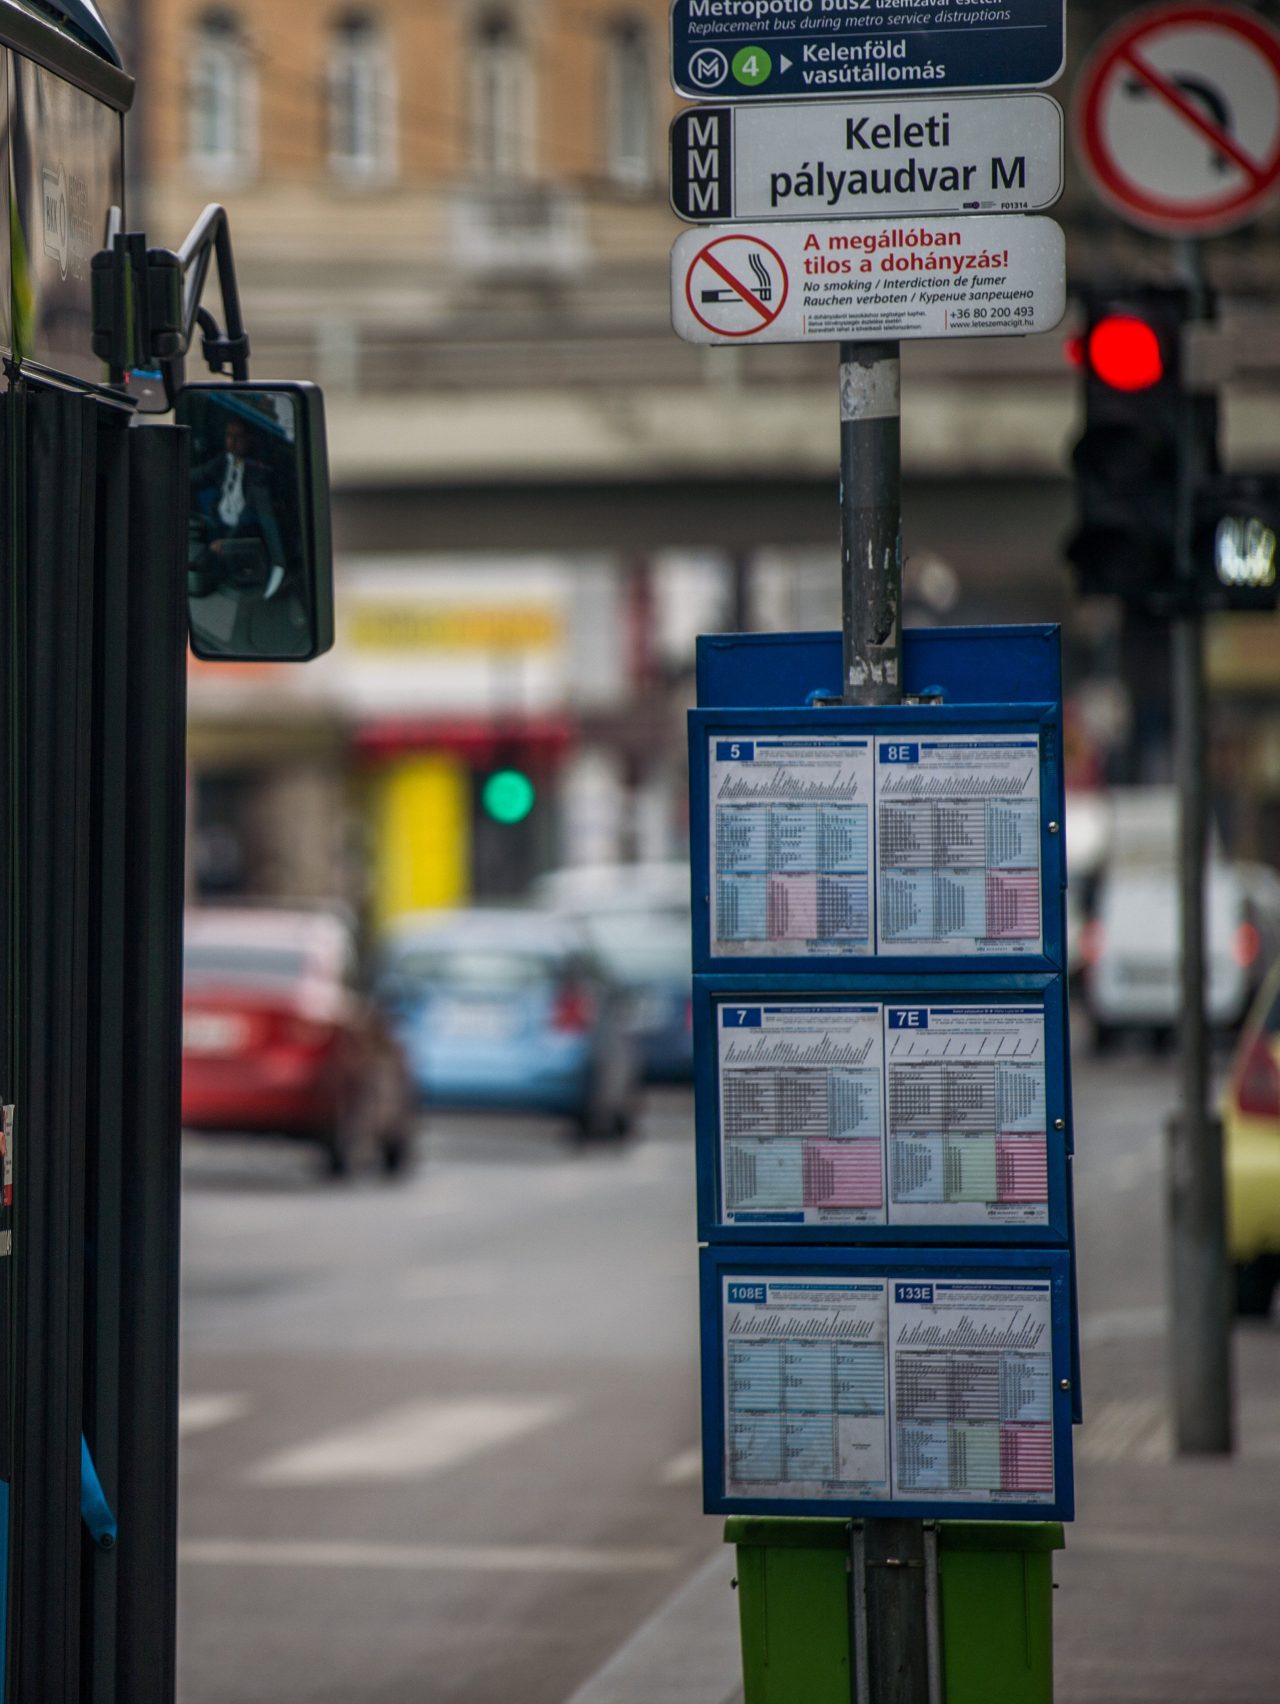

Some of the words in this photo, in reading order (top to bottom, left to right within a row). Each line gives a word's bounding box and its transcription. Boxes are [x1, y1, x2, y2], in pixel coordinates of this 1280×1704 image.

[821, 0, 871, 11] busz
[688, 19, 770, 36] Replacement
[774, 18, 796, 30] bus
[800, 16, 841, 31] during
[845, 15, 884, 26] metro
[887, 12, 931, 24] service
[934, 9, 1011, 24] distruptions
[741, 55, 760, 77] 4
[802, 39, 907, 62] Kelenföld
[802, 60, 946, 84] vasútállomás
[688, 116, 719, 147] M
[846, 112, 950, 150] Keleti
[688, 149, 719, 179] M
[770, 158, 977, 208] pályaudvar
[991, 156, 1026, 190] M
[688, 182, 719, 212] M
[1000, 201, 1028, 210] F01314
[804, 233, 820, 251] A
[828, 228, 961, 254] megállóban
[804, 255, 852, 275] tilos
[860, 258, 872, 272] a
[880, 250, 1008, 275] dohányzás!
[803, 282, 820, 292] No
[824, 280, 872, 292] smoking
[883, 276, 950, 289] Interdiction
[954, 276, 968, 287] de
[970, 274, 1006, 289] fumer
[803, 294, 852, 306] Rauchen
[856, 293, 908, 304] verboten
[919, 291, 966, 304] Курение
[968, 290, 1034, 302] запрещено
[950, 308, 970, 319] +36
[973, 308, 988, 318] 80
[990, 307, 1011, 318] 200
[1013, 306, 1034, 317] 493
[950, 318, 1034, 328] www.leteszemacigit.hu
[730, 744, 740, 759] 5
[888, 746, 910, 761] 8E
[736, 1010, 746, 1024] 7
[896, 1012, 920, 1026] 7E
[731, 1287, 764, 1300] 108E
[898, 1287, 931, 1300] 133E
